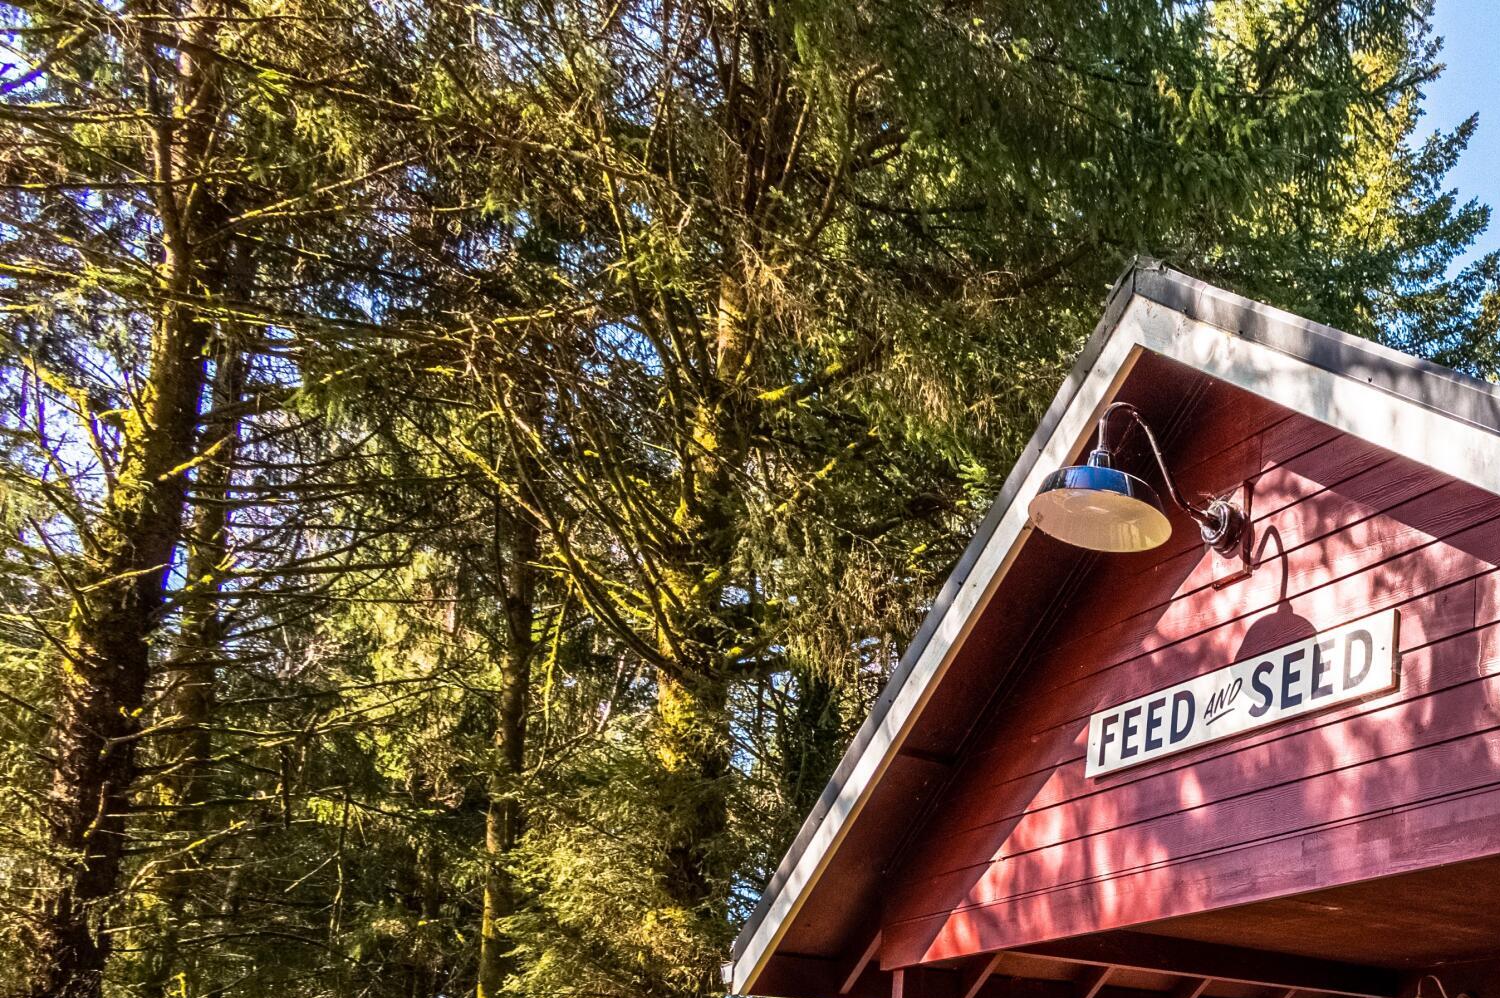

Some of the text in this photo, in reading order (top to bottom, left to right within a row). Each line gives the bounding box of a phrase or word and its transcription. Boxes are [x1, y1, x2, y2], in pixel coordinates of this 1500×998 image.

[1098, 629, 1374, 766] FEED AND SEED
